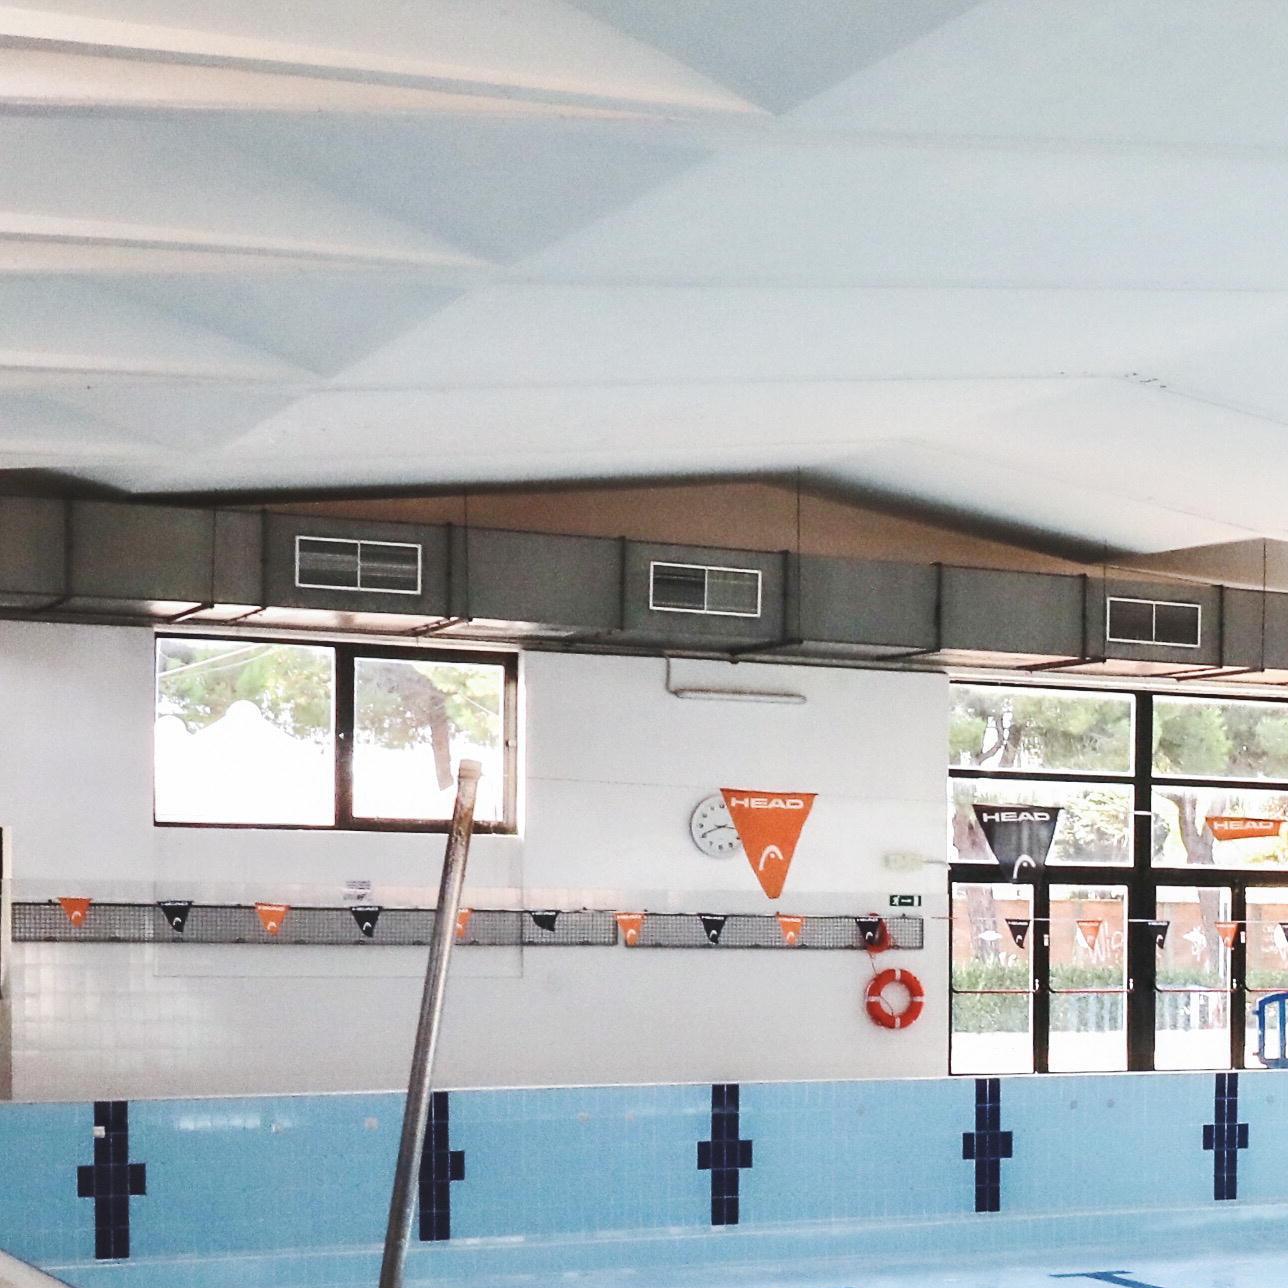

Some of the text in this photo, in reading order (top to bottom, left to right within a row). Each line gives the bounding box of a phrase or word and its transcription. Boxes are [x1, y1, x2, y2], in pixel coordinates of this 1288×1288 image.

[731, 797, 804, 809] HEAD
[983, 812, 1050, 823] HEAD
[1213, 821, 1274, 830] HEAD
